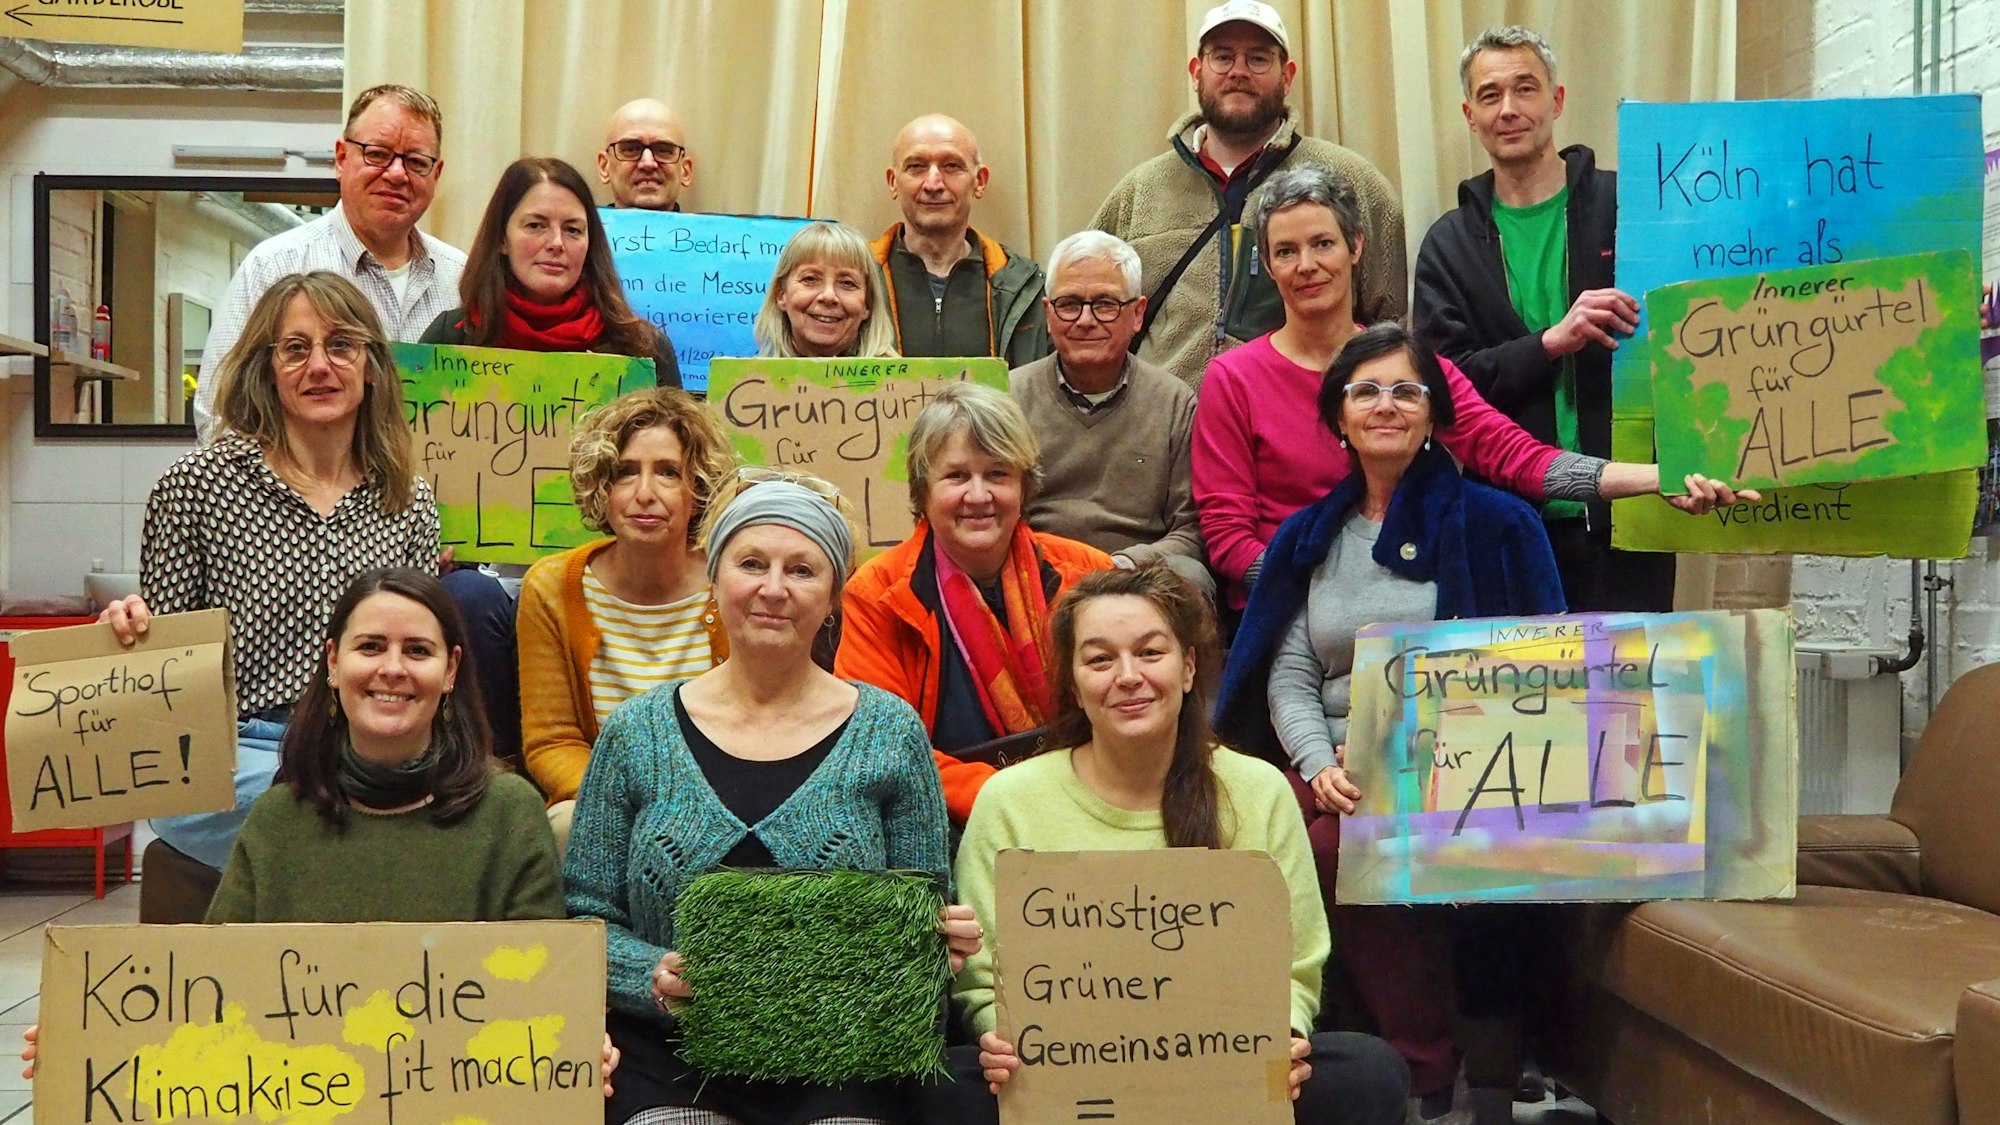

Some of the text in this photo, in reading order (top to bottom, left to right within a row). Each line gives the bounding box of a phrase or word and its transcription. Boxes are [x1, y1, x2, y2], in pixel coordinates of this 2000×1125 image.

[1657, 132, 1884, 210] Köln hat
[602, 222, 656, 252] rst
[667, 228, 752, 261] Bedarf
[1693, 218, 1843, 268] mehr als
[655, 273, 686, 293] die
[702, 270, 767, 295] Messu
[1753, 276, 1854, 301] Innerer
[1680, 279, 1927, 378] Grüngürtel
[434, 346, 515, 377] Innerer
[825, 363, 908, 378] INNERER
[1747, 366, 1794, 403] für
[725, 370, 966, 461] Grüngürt
[1736, 389, 1889, 480] ALLE
[422, 442, 456, 472] für
[773, 437, 819, 466] für
[433, 466, 575, 549] LLE
[1715, 490, 1853, 528] verdient
[1490, 621, 1605, 646] INNERER
[1385, 643, 1669, 715] Grüngürtel
[74, 709, 117, 746] für
[30, 734, 190, 811] ALLE!
[1399, 729, 1689, 836] für ALLE
[1022, 884, 1235, 951] Günstiger
[83, 949, 486, 1040] Köln für die
[1023, 961, 1172, 1004] Grüner
[1017, 1024, 1272, 1067] Gemeinsamer
[84, 1025, 593, 1125] Klimakrise fit machen
